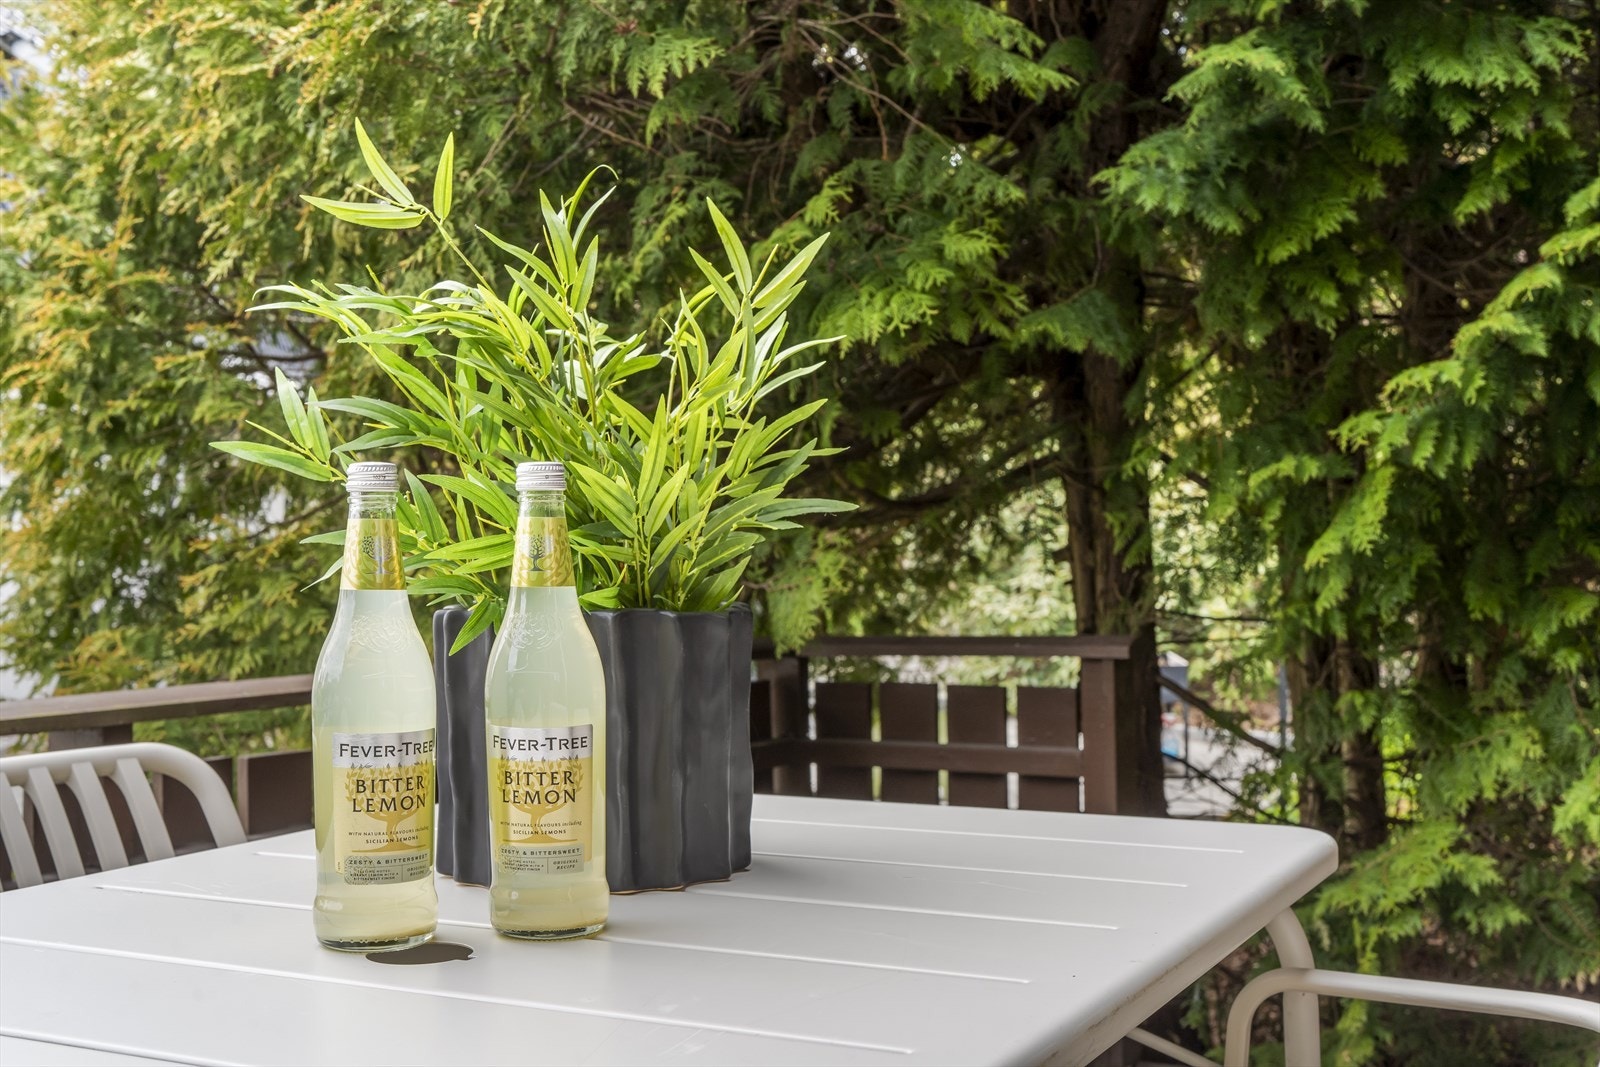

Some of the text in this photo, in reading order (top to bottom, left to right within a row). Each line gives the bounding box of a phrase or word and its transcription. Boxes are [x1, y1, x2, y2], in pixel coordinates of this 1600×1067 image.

[339, 739, 434, 758] FEVER-TREE
[493, 734, 588, 751] FEVER-TREE
[355, 775, 425, 794] BITTER
[504, 770, 575, 786] BITTER
[352, 794, 426, 813] LEMON
[502, 788, 577, 805] LEMON
[396, 835, 419, 843] LEMONS
[384, 853, 428, 864] BITTERSWEET
[530, 848, 580, 856] BITTERSWEET
